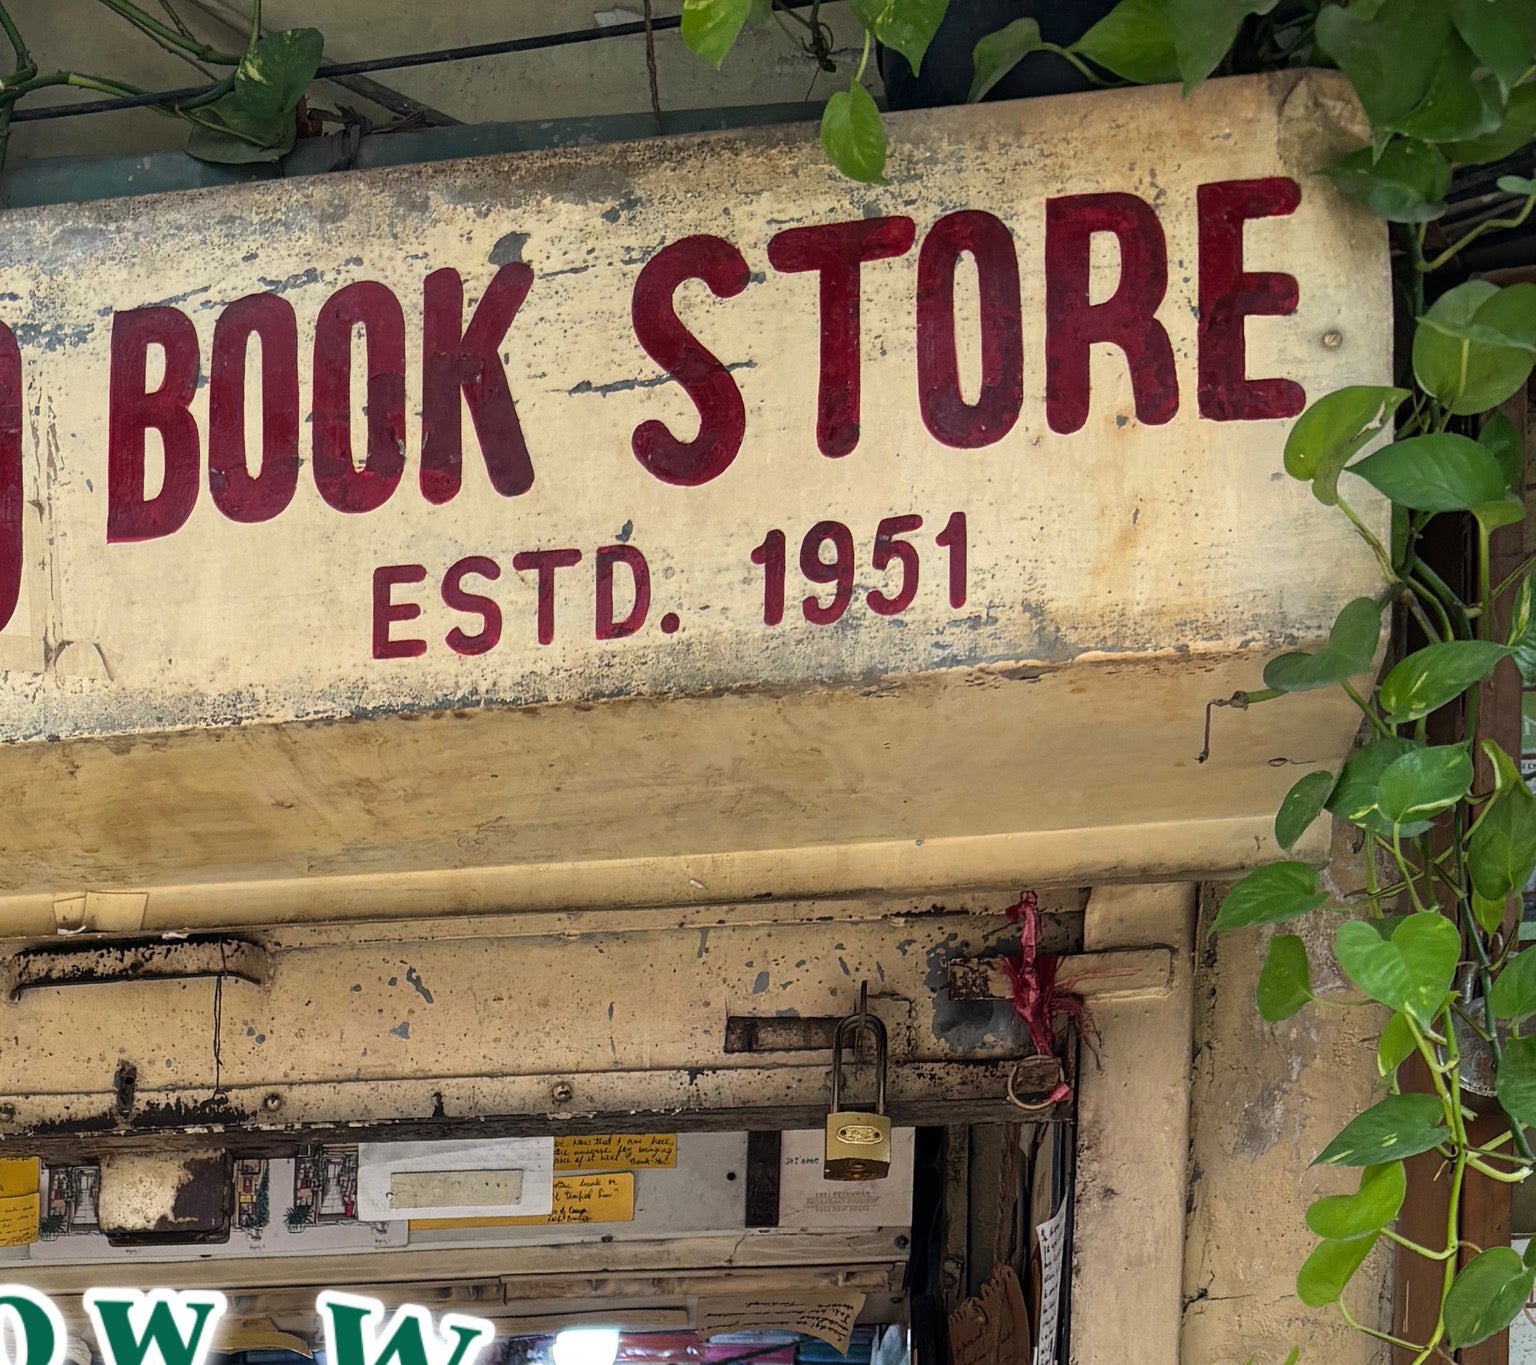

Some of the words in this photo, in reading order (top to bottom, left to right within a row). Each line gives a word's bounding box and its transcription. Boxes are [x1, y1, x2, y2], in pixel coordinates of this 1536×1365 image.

[106, 260, 536, 545] BOOK
[630, 175, 1308, 488] STORE
[371, 544, 682, 661] ESTD.
[749, 511, 969, 627] 1951
